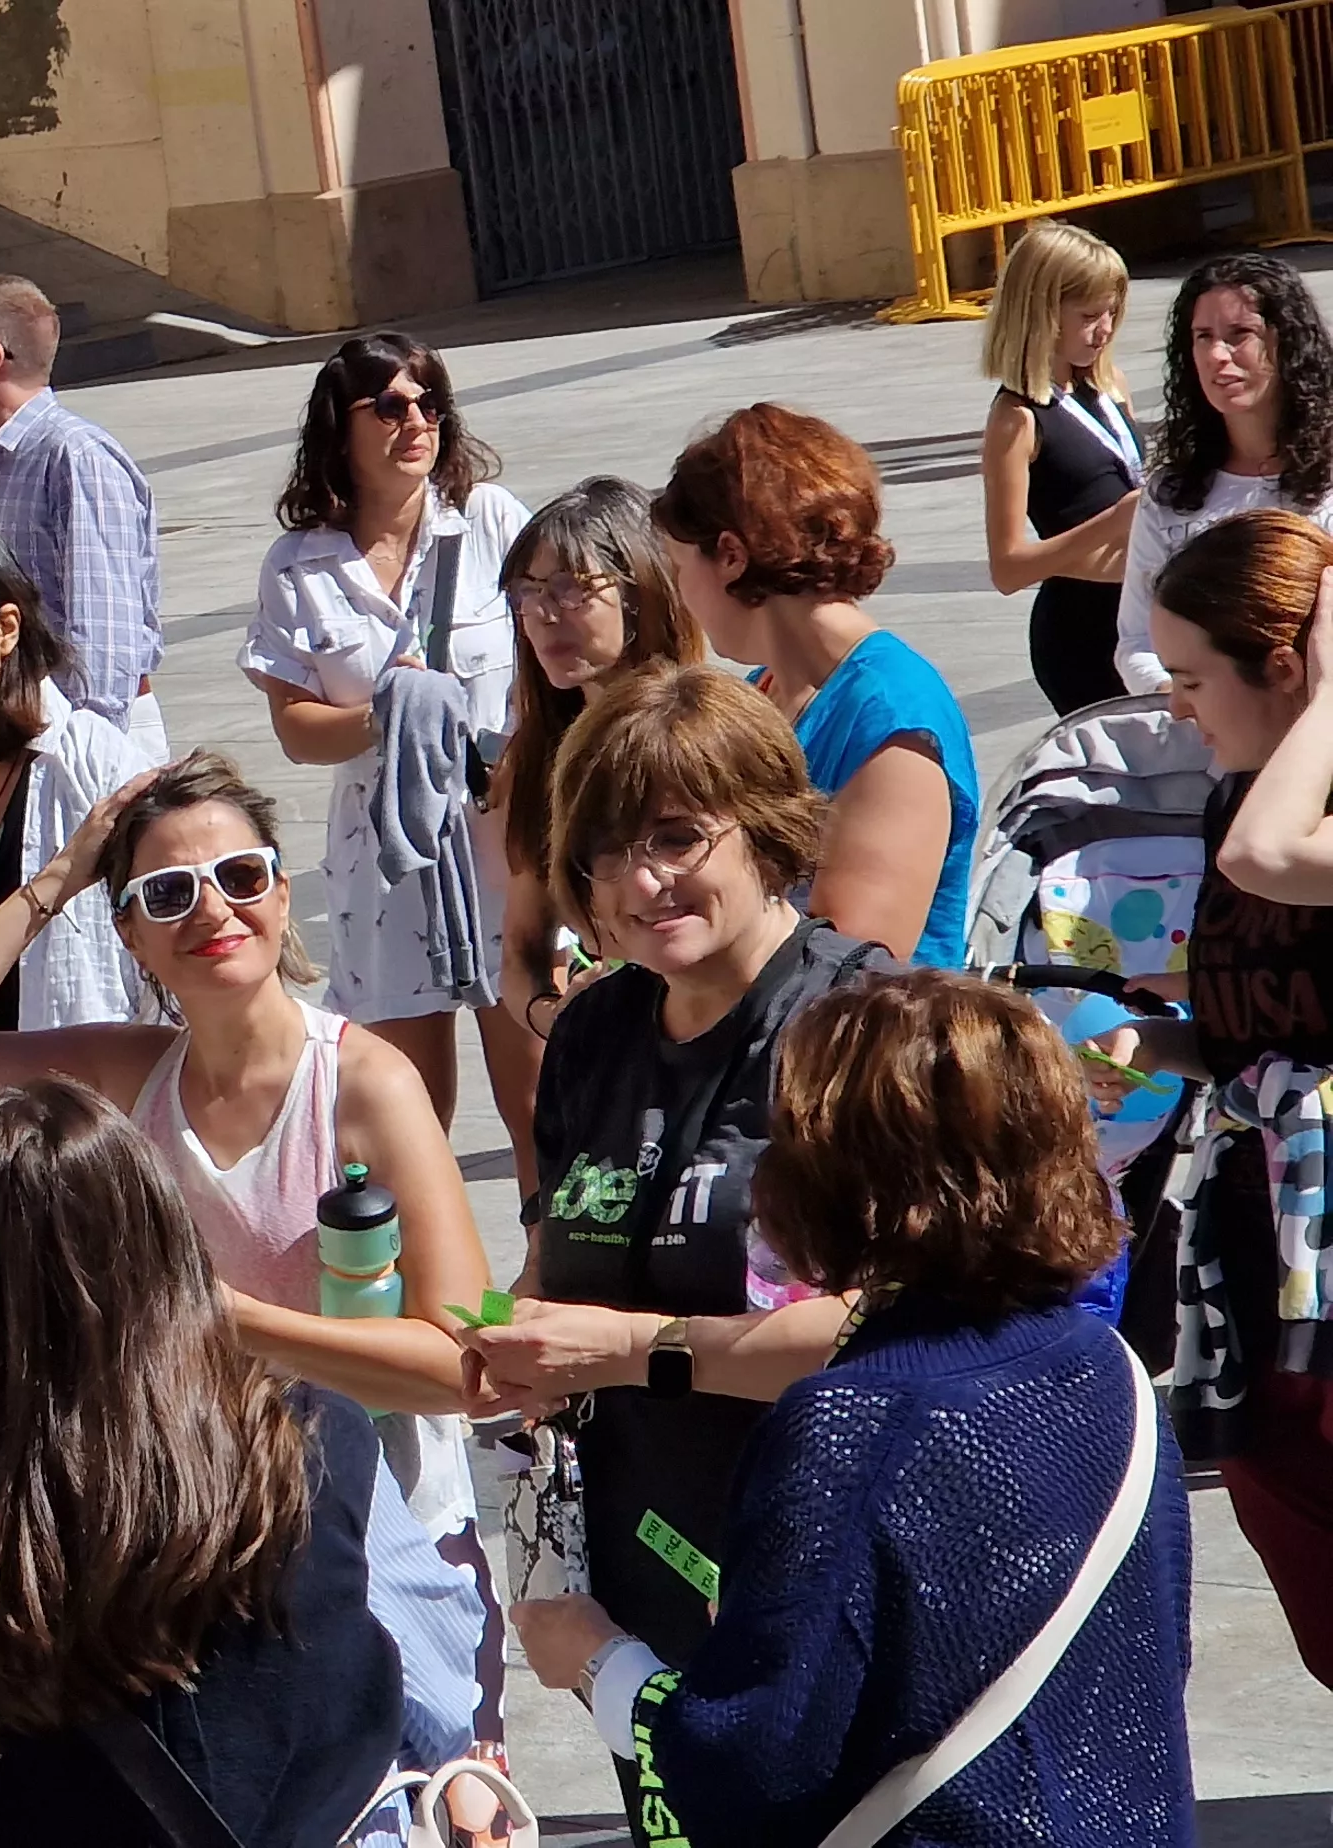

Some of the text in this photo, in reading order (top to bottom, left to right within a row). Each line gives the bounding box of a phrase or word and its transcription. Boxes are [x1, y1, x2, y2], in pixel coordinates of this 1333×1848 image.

[1195, 969, 1329, 1040] AUSA
[547, 1152, 638, 1224] be
[669, 1163, 728, 1224] iT
